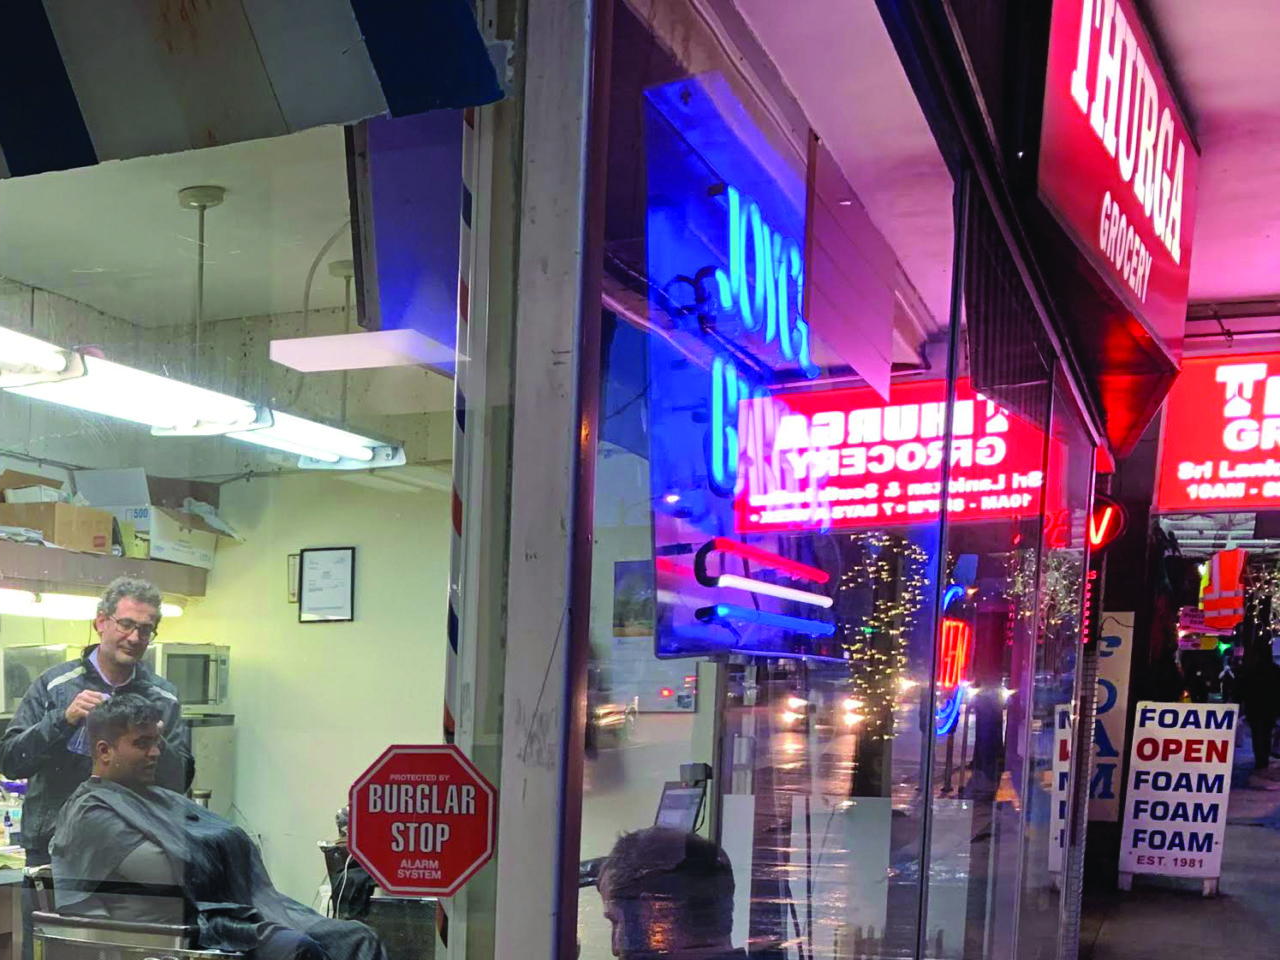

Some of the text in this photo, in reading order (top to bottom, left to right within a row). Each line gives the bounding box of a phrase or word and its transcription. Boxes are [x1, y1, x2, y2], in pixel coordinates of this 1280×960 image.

[1099, 190, 1152, 304] GROCERY
[1139, 708, 1235, 730] FOAM
[1136, 737, 1229, 763] OPEN
[389, 773, 450, 782] PROTECTED BY
[1133, 770, 1225, 794] FOAM
[368, 784, 476, 815] BURGLAR
[1132, 800, 1220, 823] FOAM
[390, 821, 450, 853] STOP
[1132, 829, 1214, 852] FOAM
[397, 869, 442, 880] SYSTEM
[399, 858, 439, 869] ALARM
[1172, 857, 1204, 869] 1981
